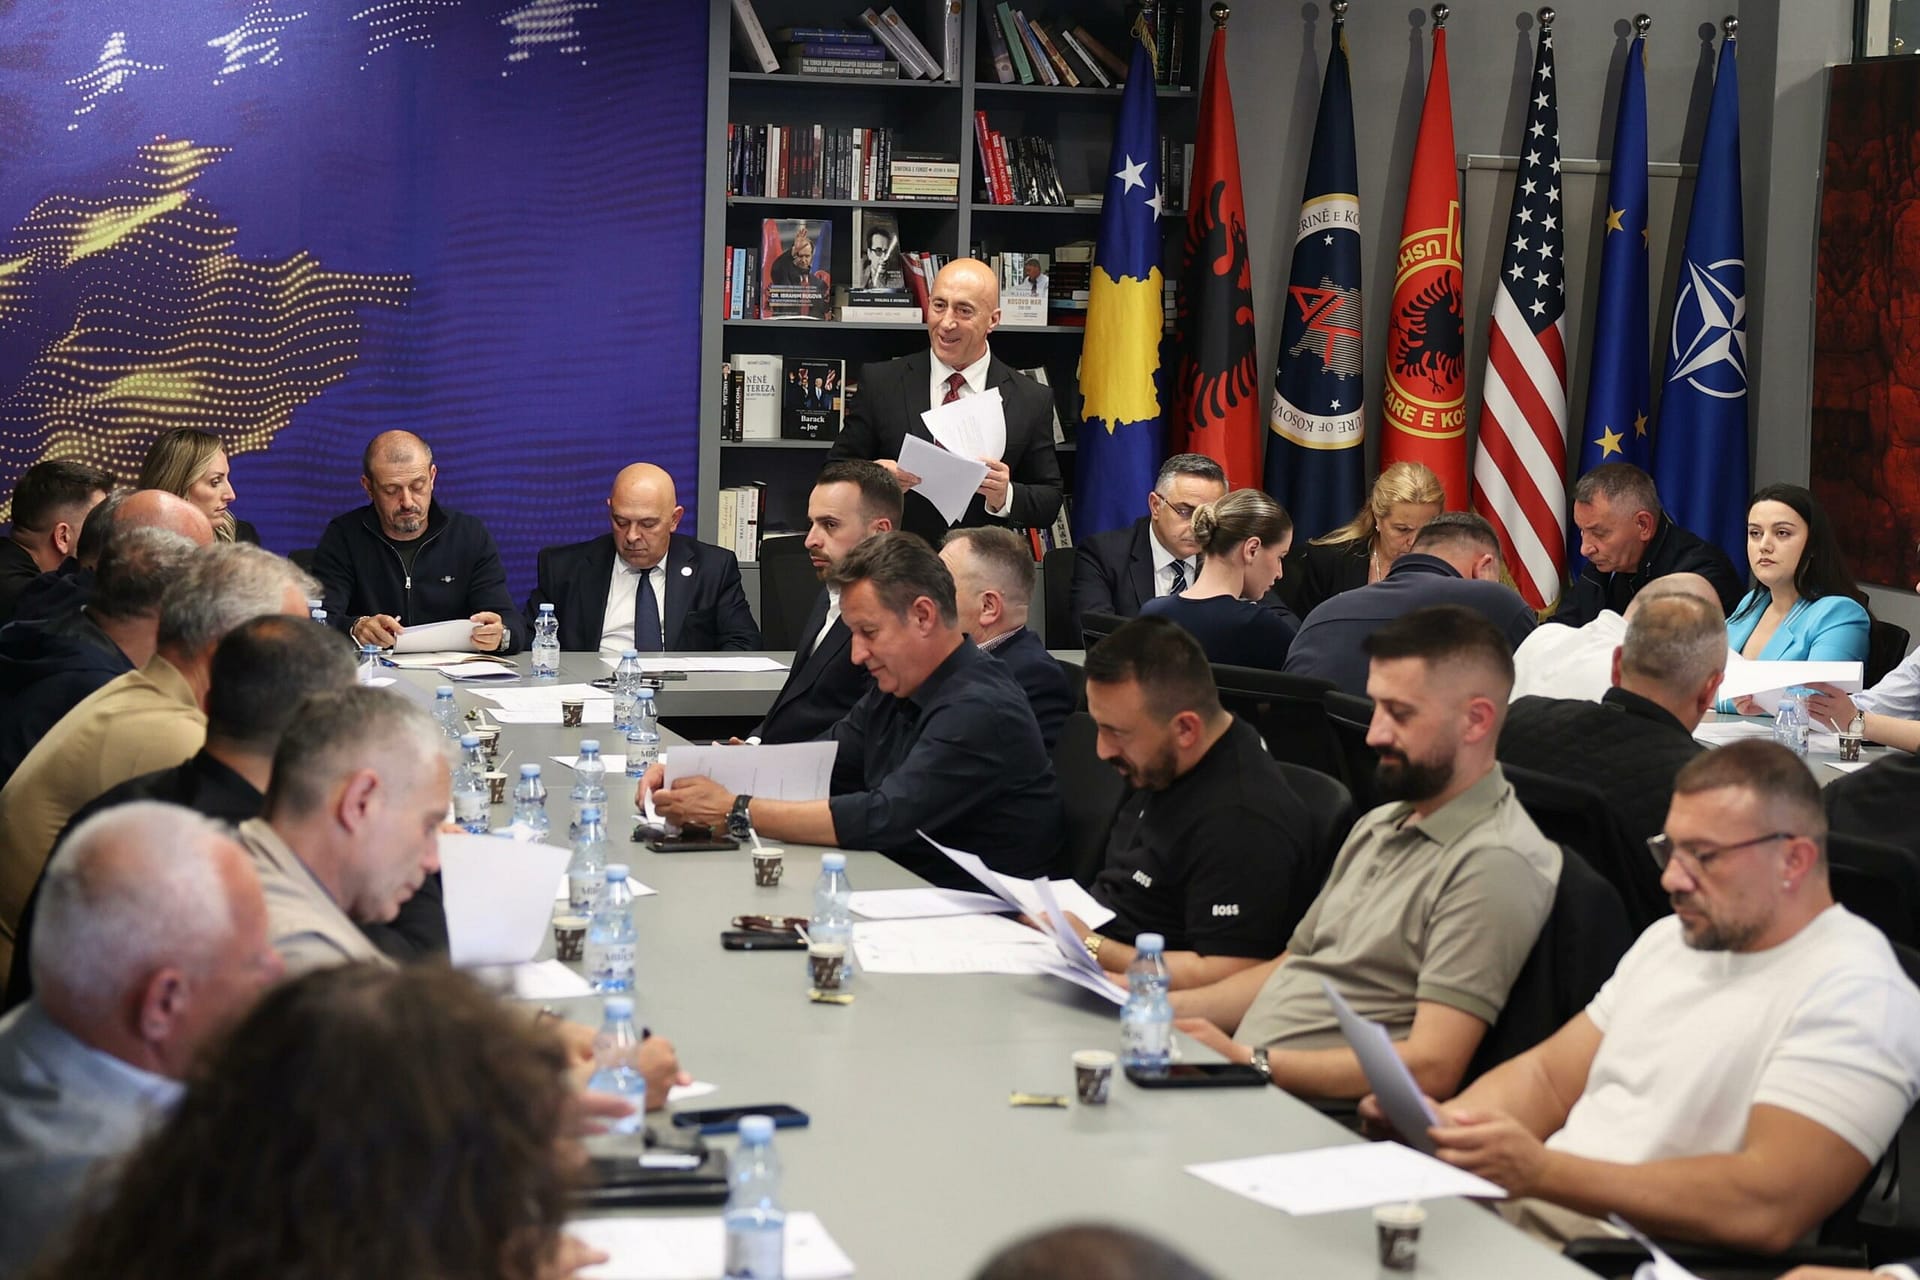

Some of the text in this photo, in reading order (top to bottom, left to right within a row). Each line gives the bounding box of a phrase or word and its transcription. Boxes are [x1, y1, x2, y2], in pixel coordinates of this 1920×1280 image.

[745, 384, 776, 393] TEREZA
[801, 415, 825, 423] Barack
[1421, 410, 1436, 428] E
[807, 423, 818, 431] Joe
[1318, 422, 1334, 433] OF
[1212, 904, 1240, 916] BOSS
